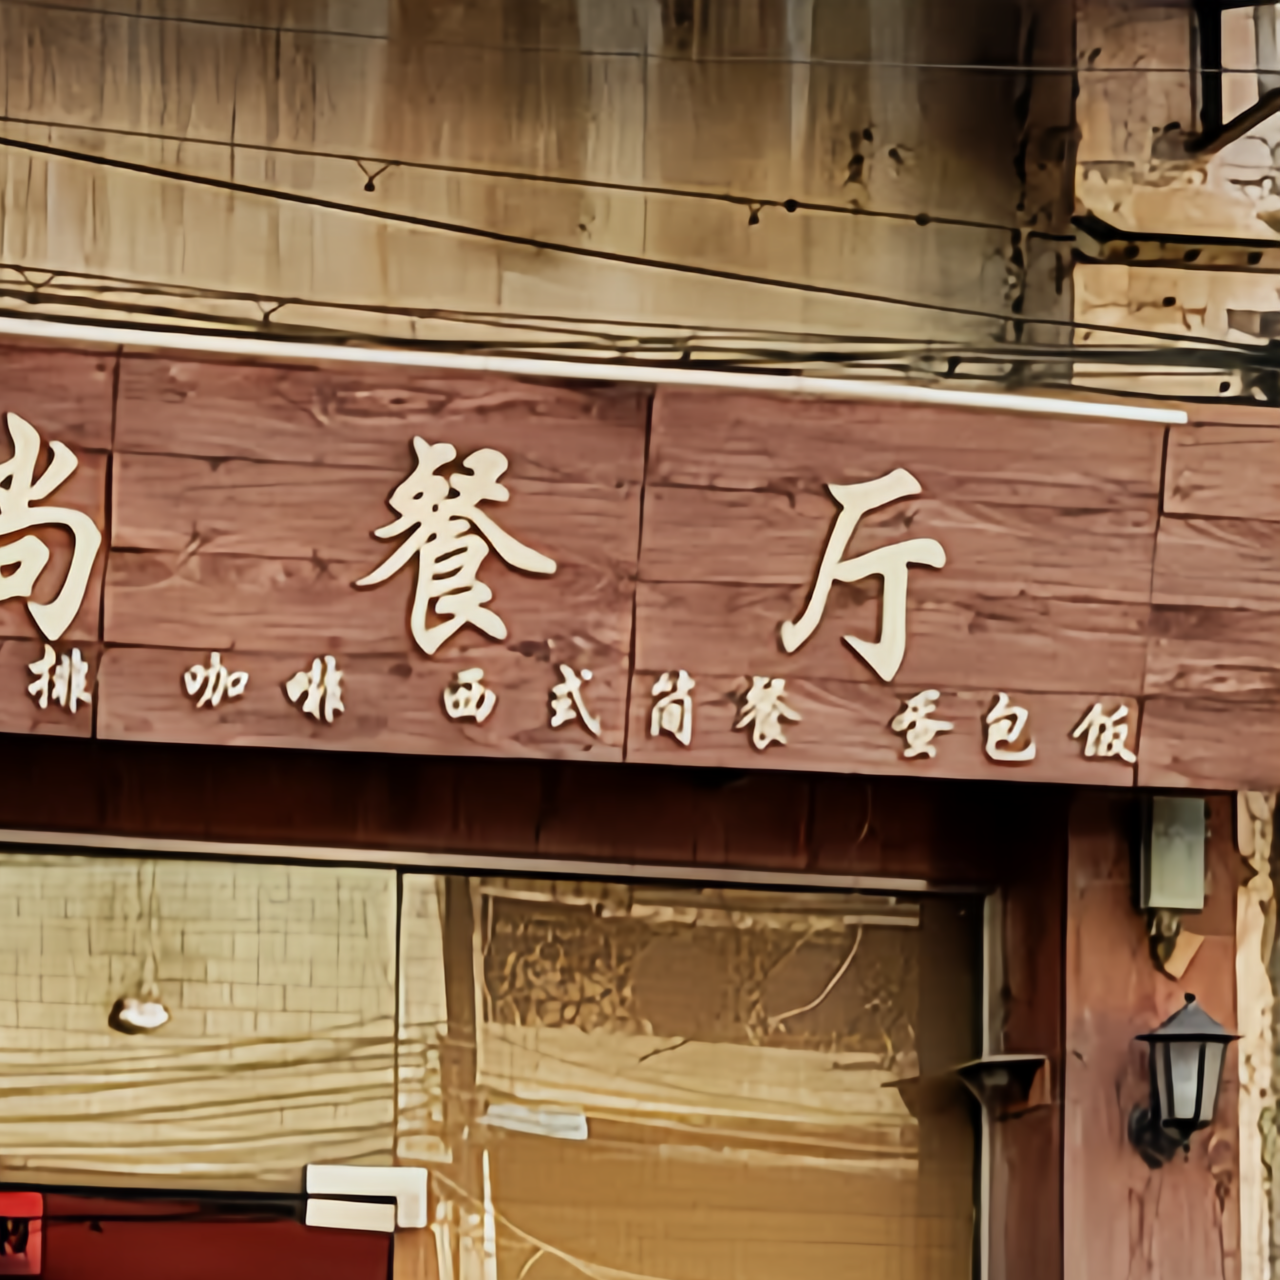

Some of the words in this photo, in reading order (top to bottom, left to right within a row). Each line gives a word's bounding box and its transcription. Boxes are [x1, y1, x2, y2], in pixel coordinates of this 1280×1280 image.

[184, 651, 346, 723] 咖啡
[443, 663, 802, 750] 西式简餐
[891, 688, 1137, 763] 蛋包饭
